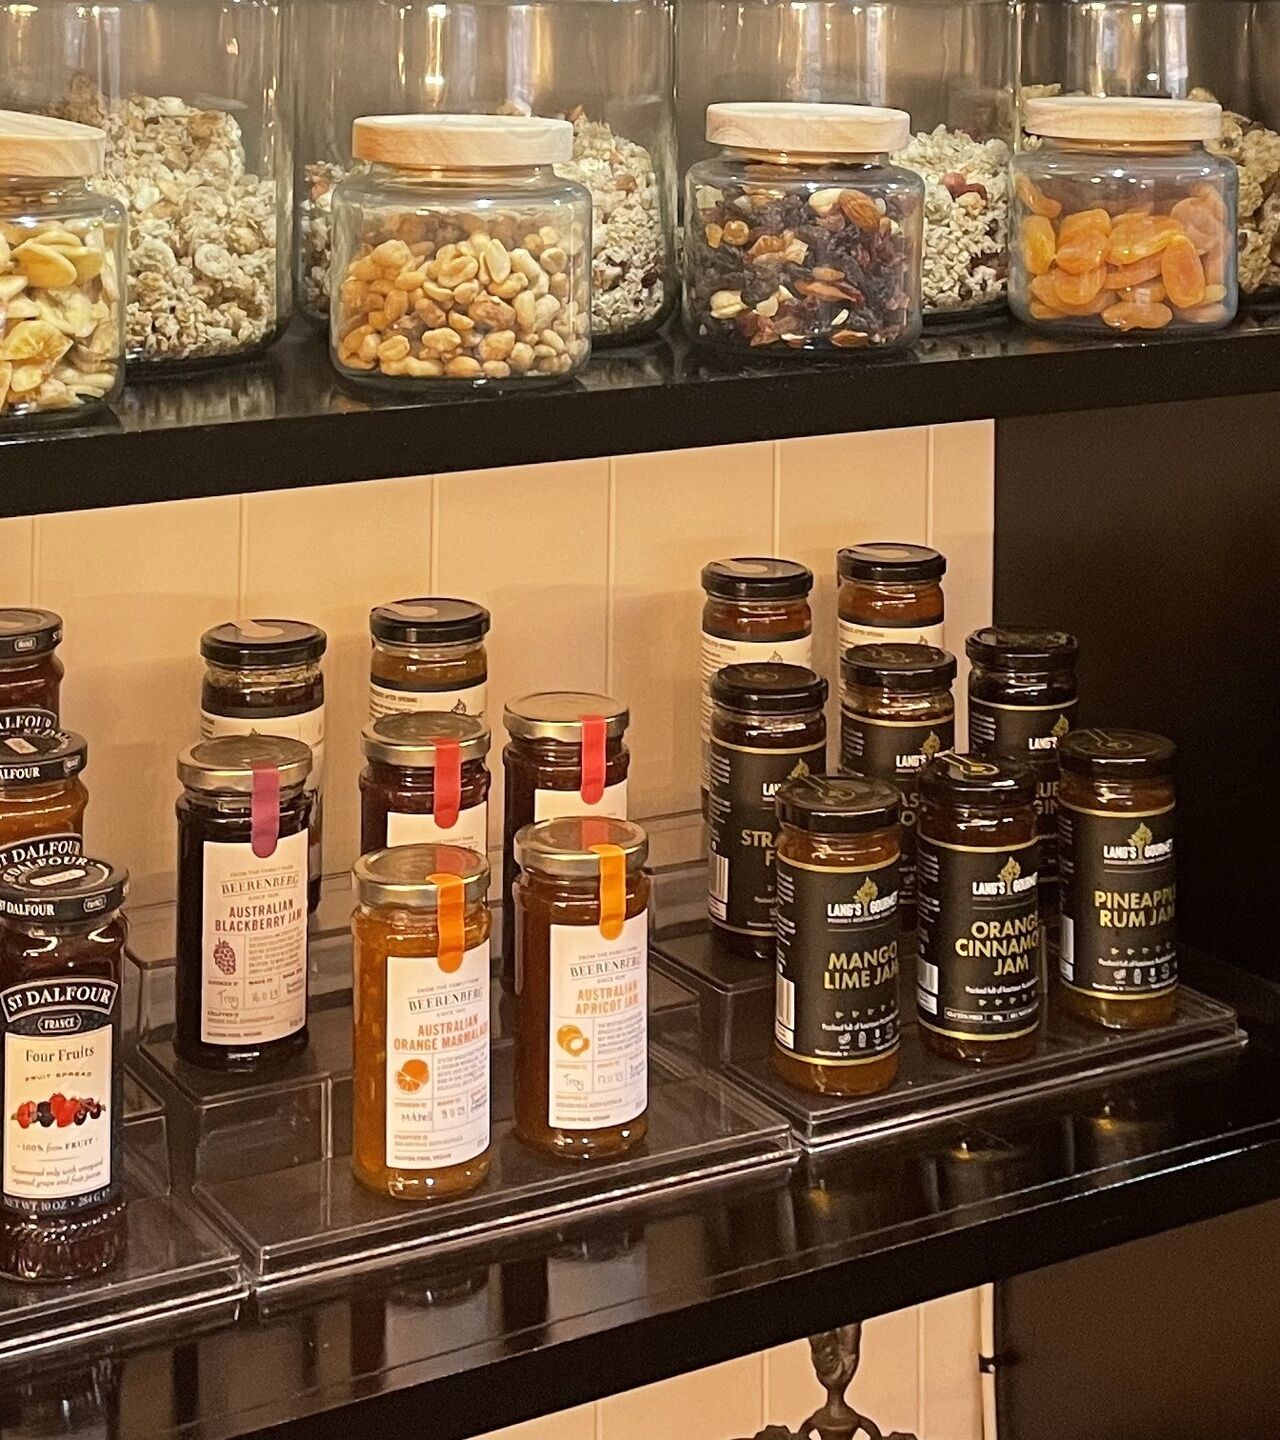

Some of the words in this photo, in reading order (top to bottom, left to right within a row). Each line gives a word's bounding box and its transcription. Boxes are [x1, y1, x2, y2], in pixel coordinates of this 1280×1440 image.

[972, 881, 1006, 895] LANG'S
[7, 902, 55, 916] DALFOUR
[229, 898, 294, 918] AUSTRALIAN
[827, 903, 862, 917] LANG'S
[215, 914, 285, 932] BLACKBERRY
[1099, 909, 1146, 928] RUM
[828, 941, 898, 970] MANGO
[993, 956, 1029, 976] JAM
[824, 970, 870, 989] LIME
[7, 994, 23, 1012] ST
[27, 986, 112, 1006] DALFOUR
[577, 979, 639, 1002] AUSTRALIAN
[575, 998, 621, 1016] APRICOT
[44, 1018, 76, 1030] FRANCE
[418, 1013, 479, 1037] AUSTRALIAN
[26, 1049, 56, 1062] Four
[58, 1045, 95, 1061] Fruits
[394, 1038, 438, 1051] ORANGE
